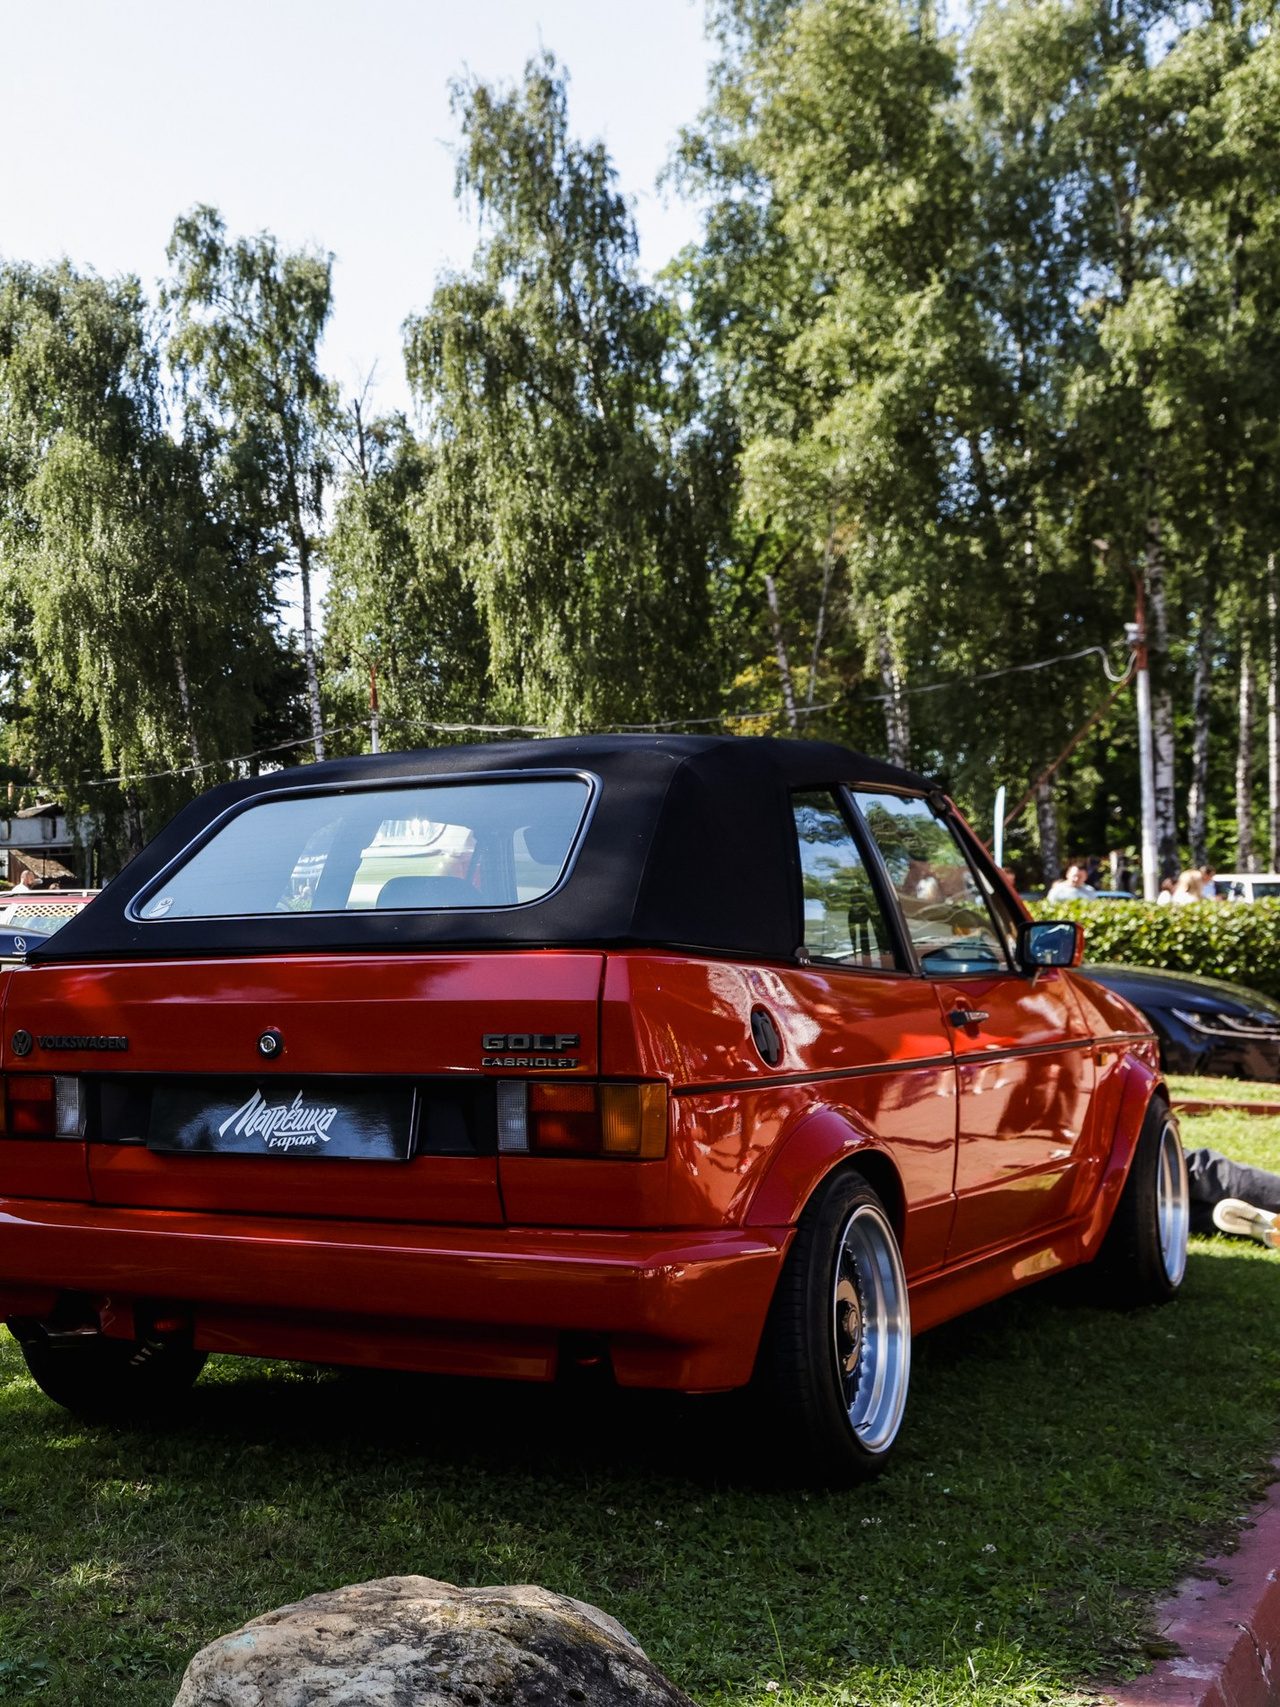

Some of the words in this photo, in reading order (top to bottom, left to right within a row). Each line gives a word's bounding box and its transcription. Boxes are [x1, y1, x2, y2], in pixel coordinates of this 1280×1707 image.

[36, 1035, 128, 1051] VOLKSWAGEN
[482, 1033, 579, 1051] GOLF
[481, 1057, 579, 1067] CABRIOLET
[218, 1088, 338, 1142] Матрёшка
[268, 1134, 318, 1152] гараж
